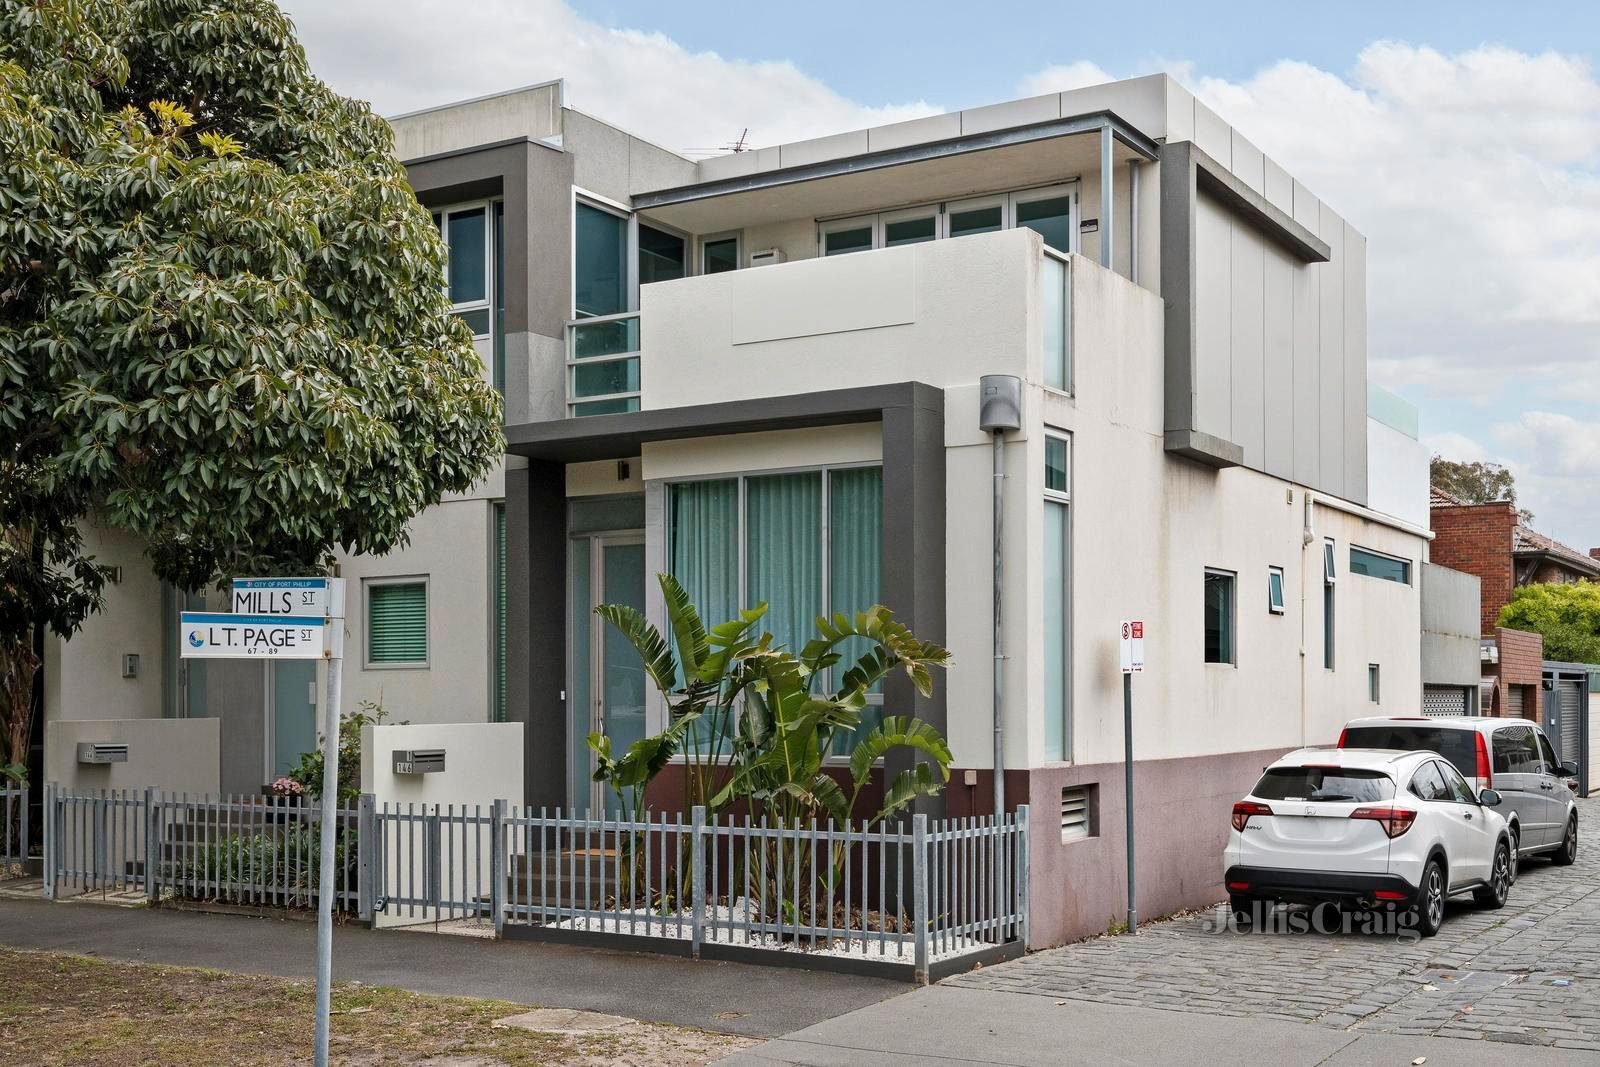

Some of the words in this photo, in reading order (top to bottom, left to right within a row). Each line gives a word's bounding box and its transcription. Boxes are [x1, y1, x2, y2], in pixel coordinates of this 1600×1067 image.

[235, 591, 292, 614] MILLS
[302, 591, 315, 603] ST
[209, 627, 238, 647] LT.
[243, 628, 296, 647] PAGE
[301, 629, 313, 639] ST
[247, 647, 257, 655] 67
[268, 647, 278, 655] 89
